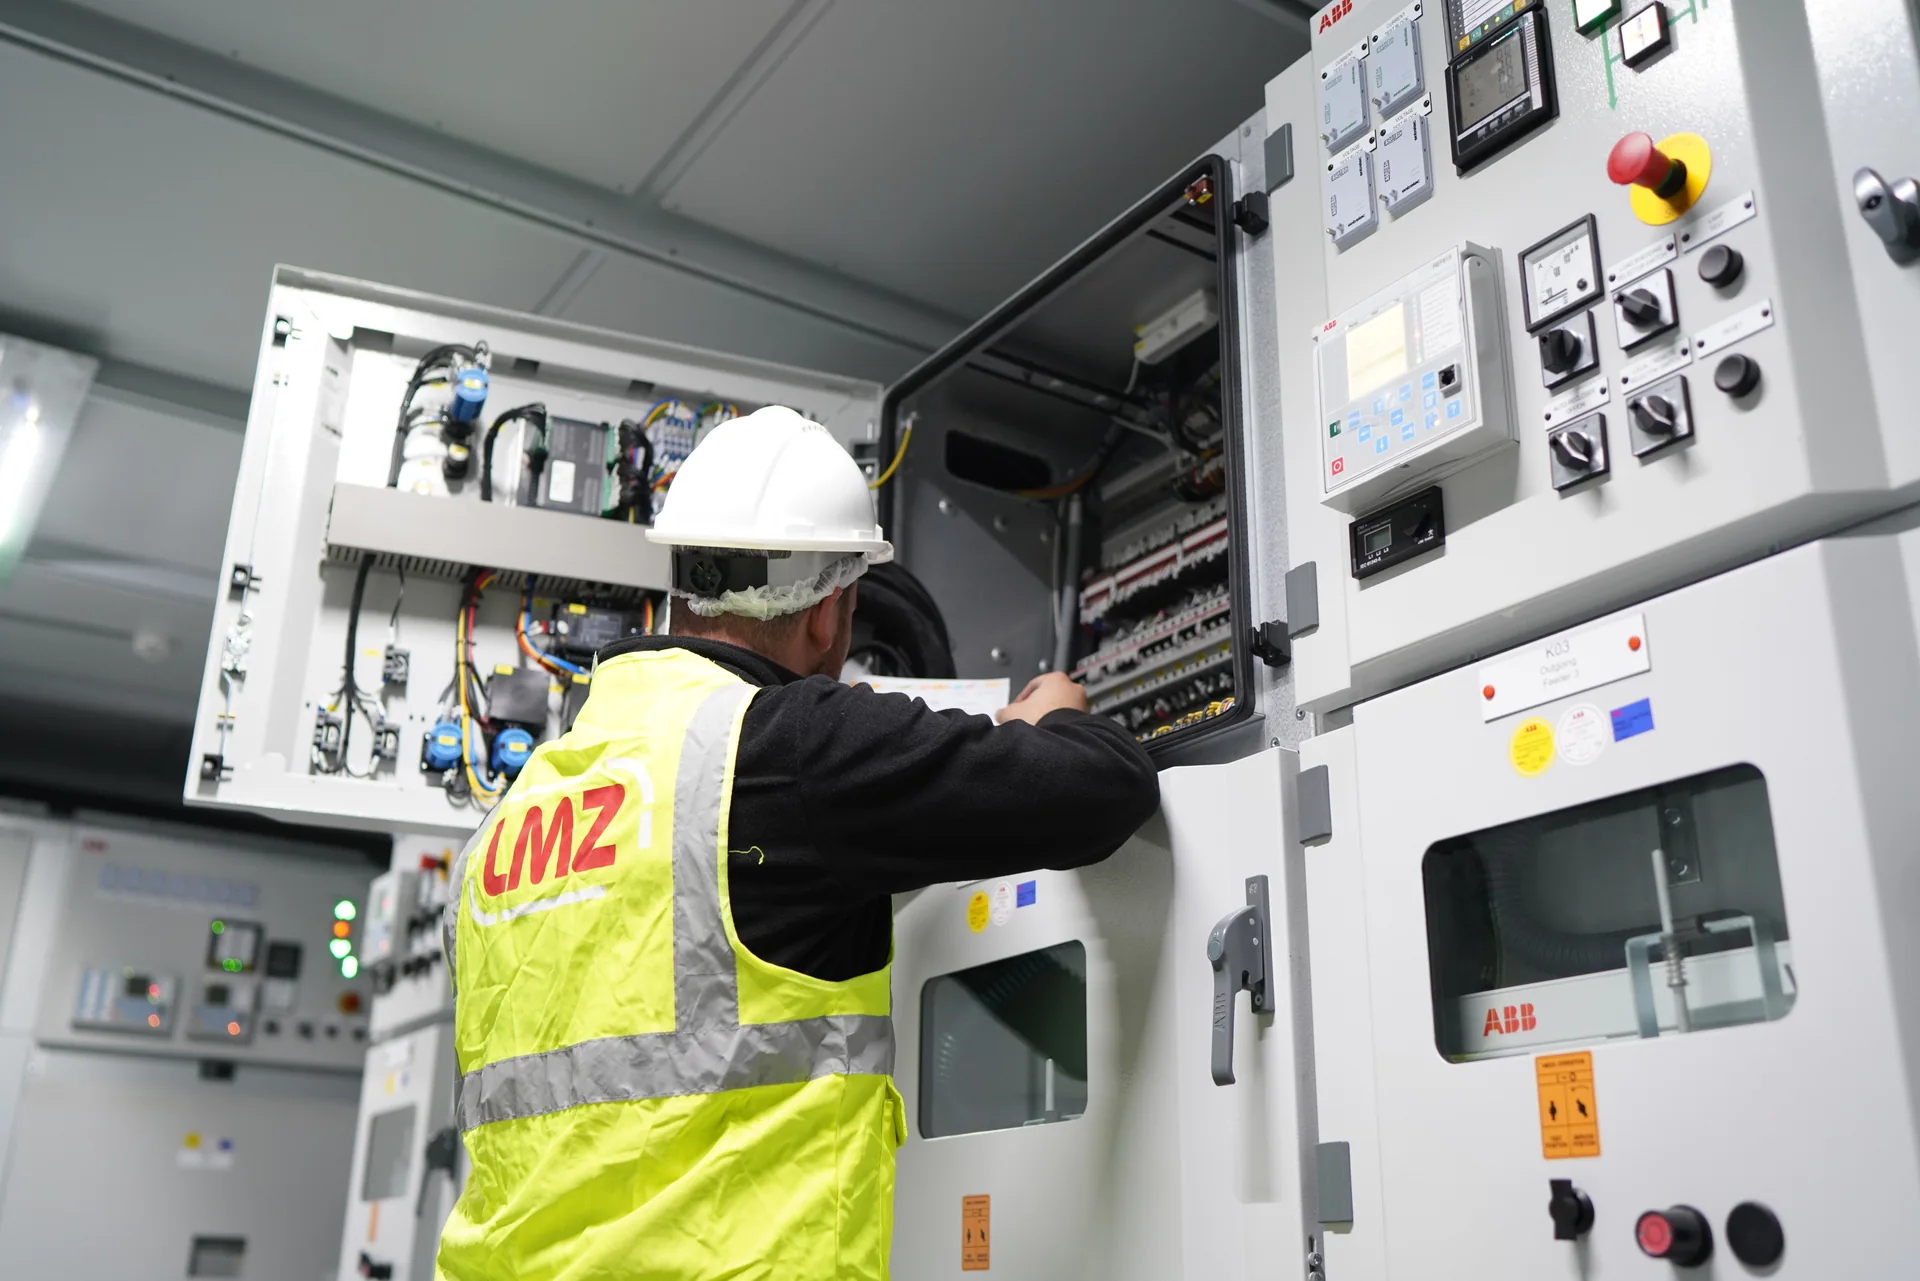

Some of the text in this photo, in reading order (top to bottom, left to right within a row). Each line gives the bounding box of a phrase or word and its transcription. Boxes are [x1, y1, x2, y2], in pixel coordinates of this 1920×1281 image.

[1319, 0, 1352, 34] ABB
[1323, 320, 1337, 332] ABB
[1545, 639, 1571, 659] K03
[1540, 657, 1577, 676] Outgoing
[483, 783, 626, 897] LMZ
[1483, 1003, 1536, 1037] ABB
